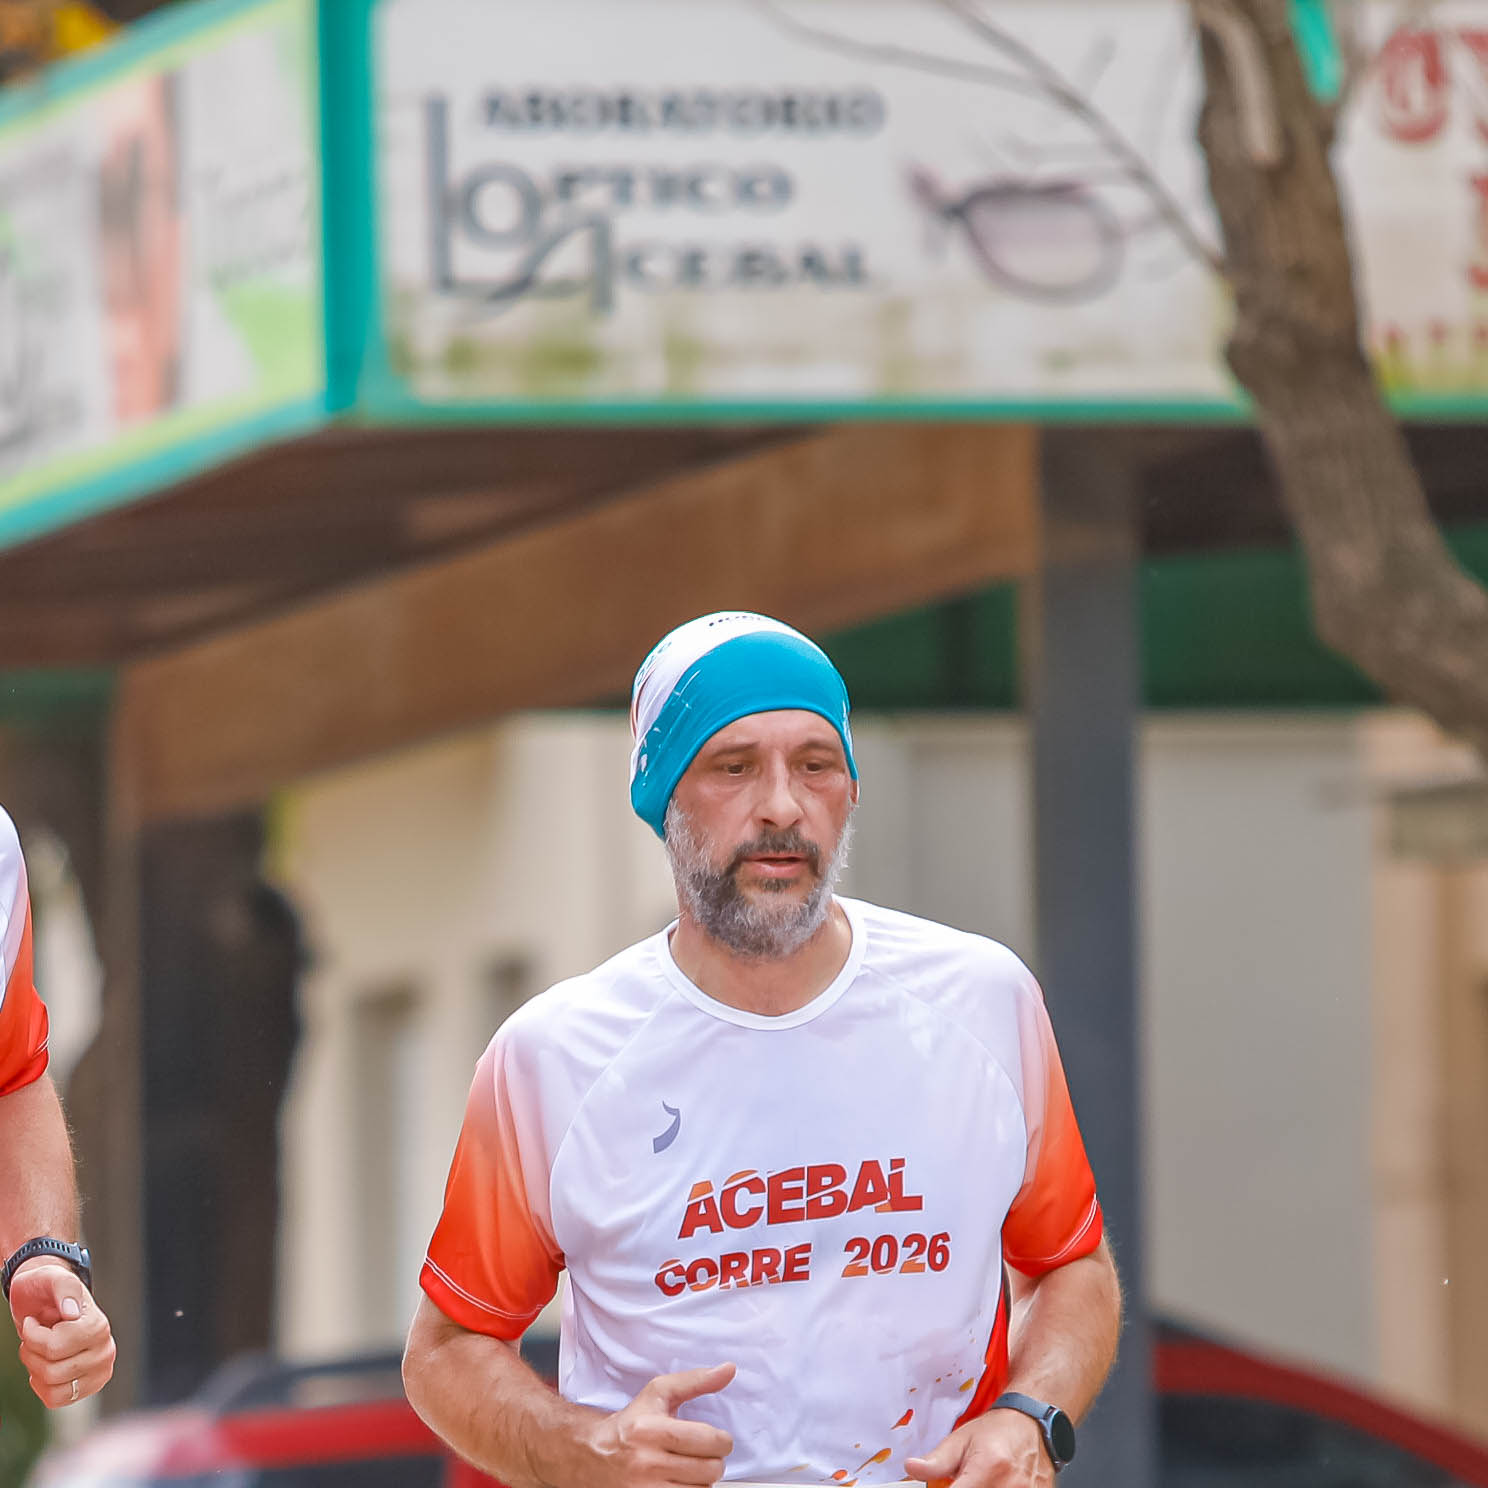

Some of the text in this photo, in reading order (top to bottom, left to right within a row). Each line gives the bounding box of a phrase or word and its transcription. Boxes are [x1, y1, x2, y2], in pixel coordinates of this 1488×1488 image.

[678, 1157, 924, 1240] ACEBAL
[654, 1231, 951, 1297] CORRE 2026
